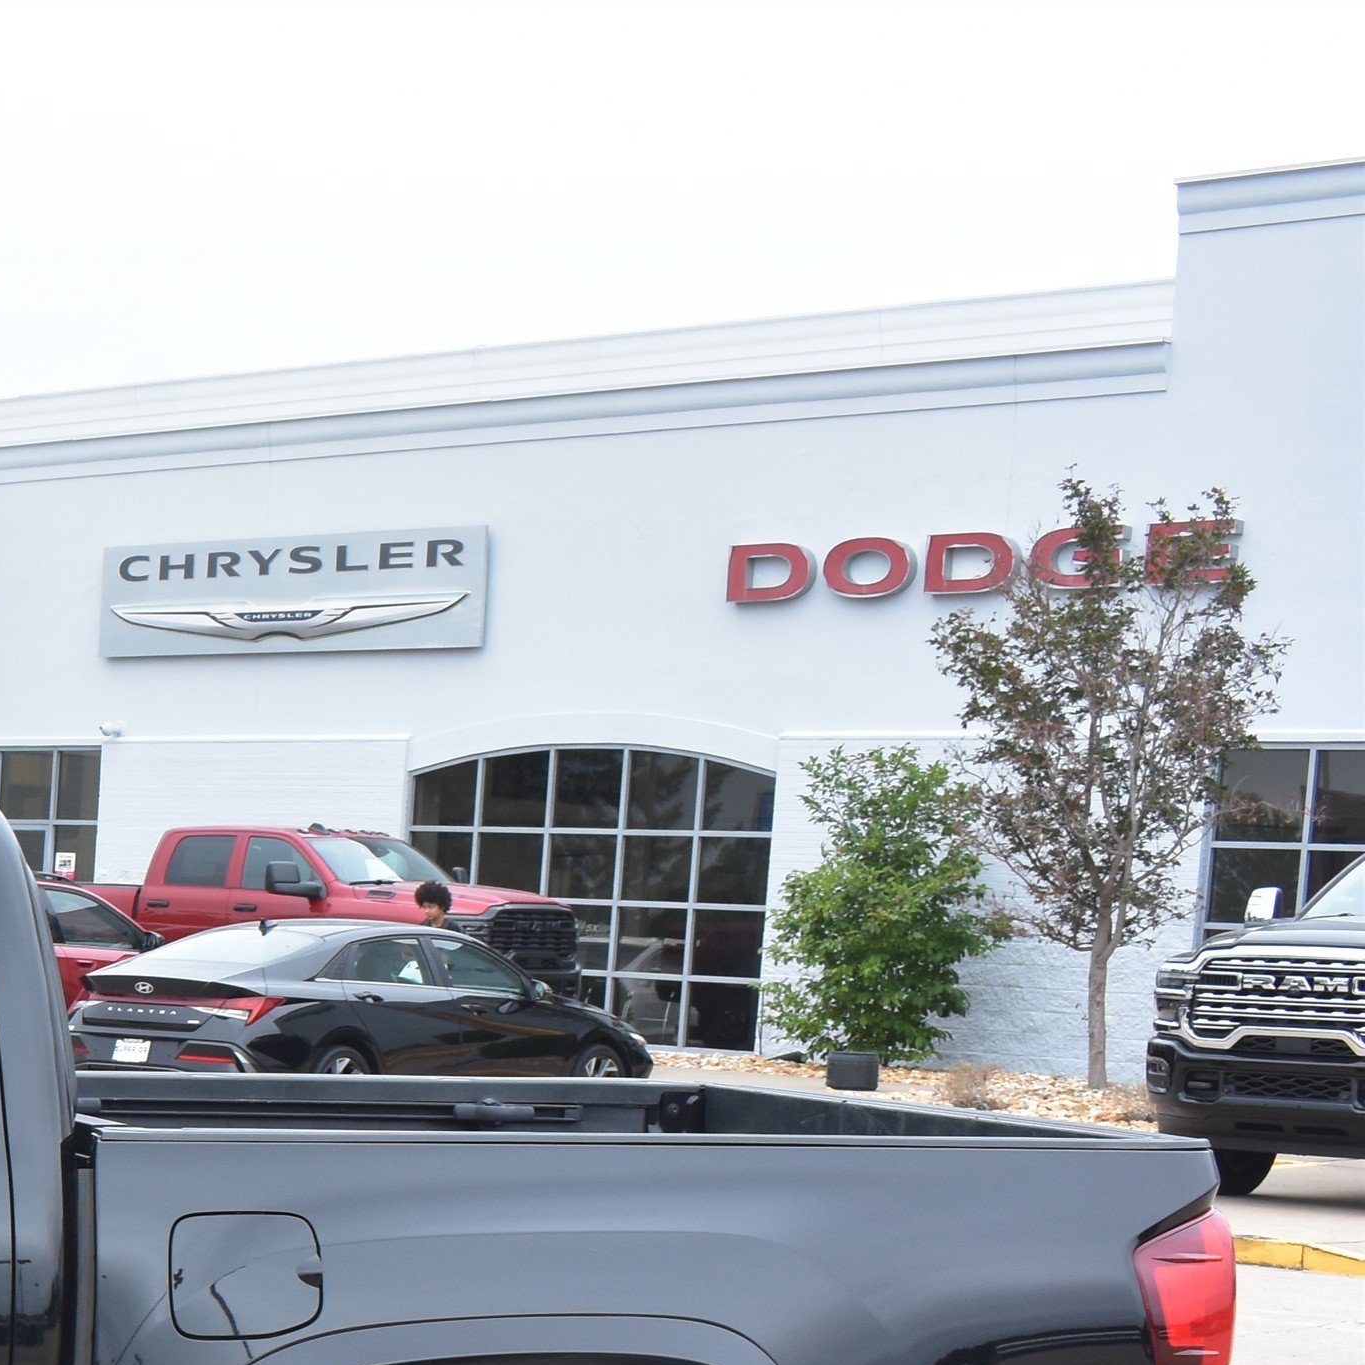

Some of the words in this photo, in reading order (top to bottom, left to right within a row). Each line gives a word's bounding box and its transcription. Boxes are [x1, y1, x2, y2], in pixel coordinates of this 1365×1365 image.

[119, 538, 465, 582] CHRYSLER
[726, 518, 1245, 603] DODGE
[243, 611, 313, 620] CHRYSLER
[1242, 974, 1350, 993] RAM
